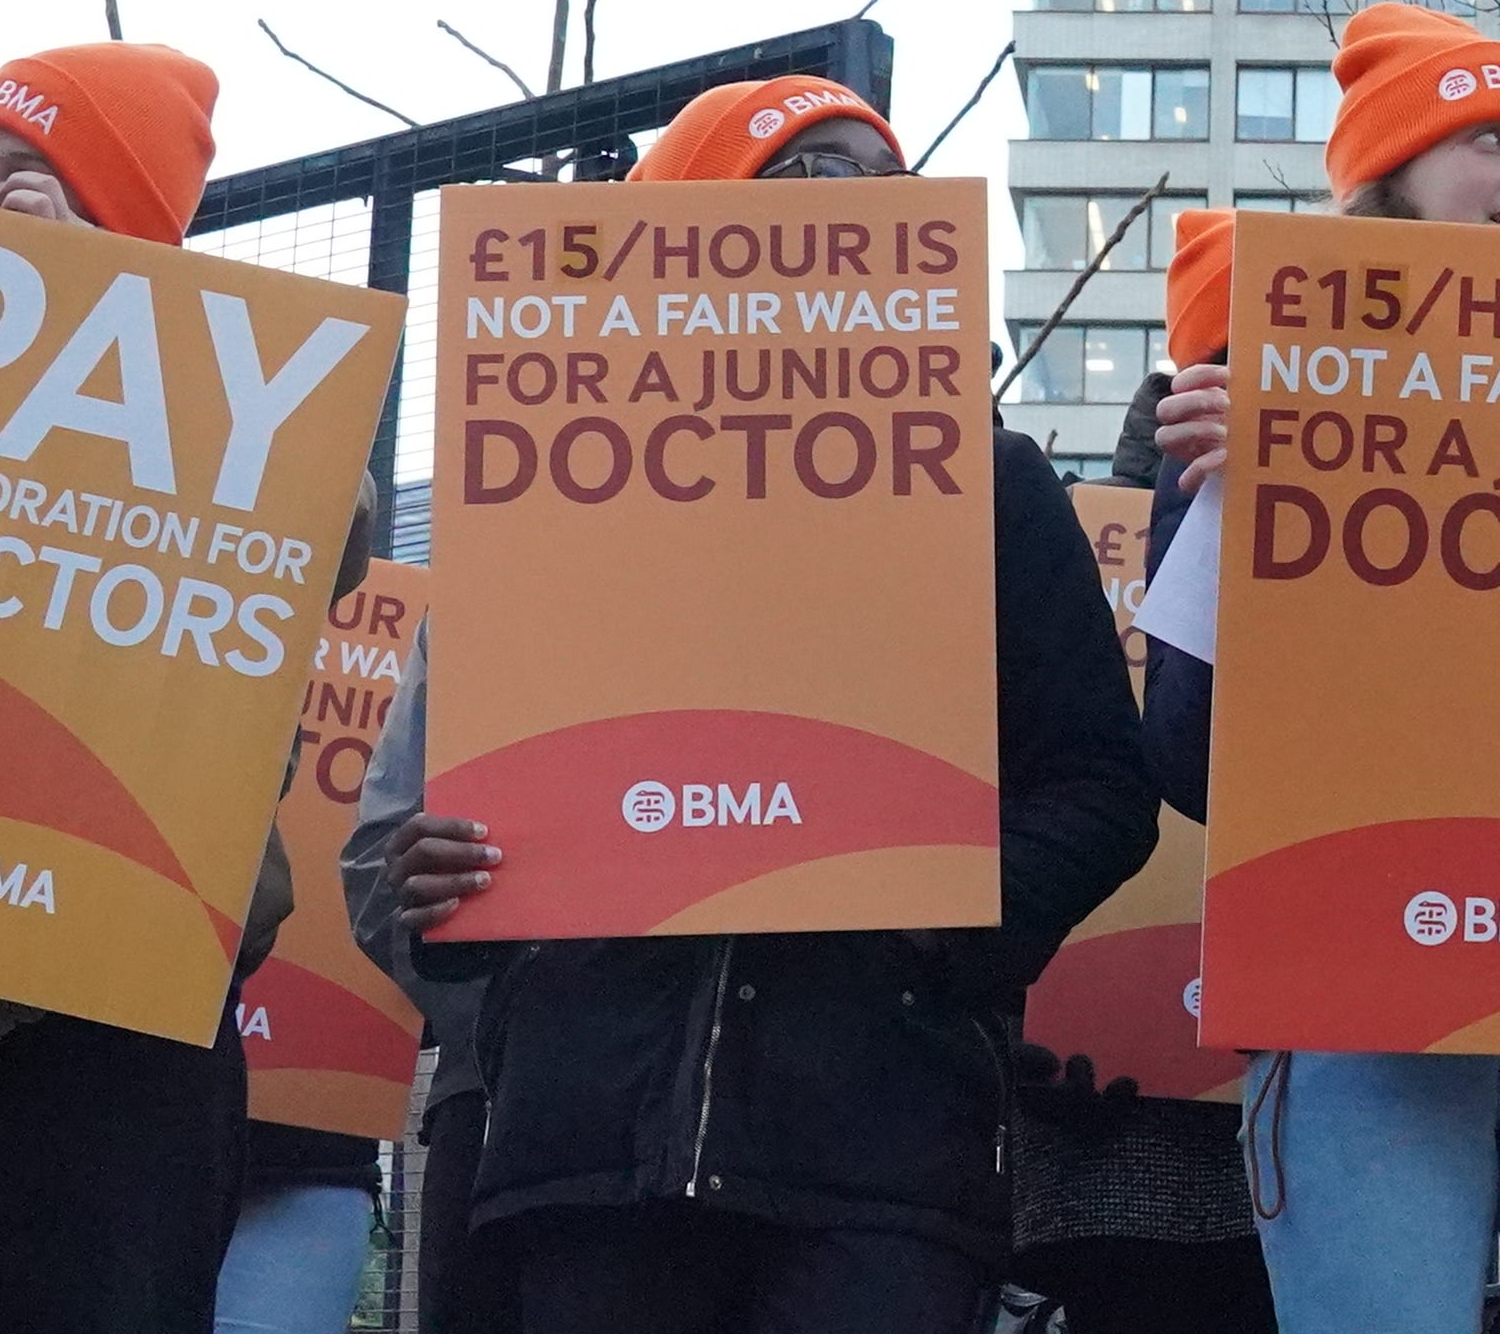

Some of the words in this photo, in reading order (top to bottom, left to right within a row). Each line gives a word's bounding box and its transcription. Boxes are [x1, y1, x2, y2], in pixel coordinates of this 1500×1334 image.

[470, 221, 871, 281] £15/HOUR
[896, 221, 958, 274] IS
[466, 295, 587, 339] NOT
[599, 294, 640, 337] A
[656, 292, 782, 336] FAIR
[795, 287, 960, 332] WAGE
[466, 353, 609, 405] FOR
[628, 351, 679, 402] A
[693, 346, 960, 412] JUNIOR
[1260, 343, 1388, 396] NOT
[1399, 352, 1442, 400] A
[464, 411, 962, 504] DOCTOR
[1258, 409, 1407, 474] FOR
[1426, 419, 1479, 477] A
[205, 522, 313, 584] FOR
[341, 641, 400, 683] WA
[682, 782, 802, 826] BMA
